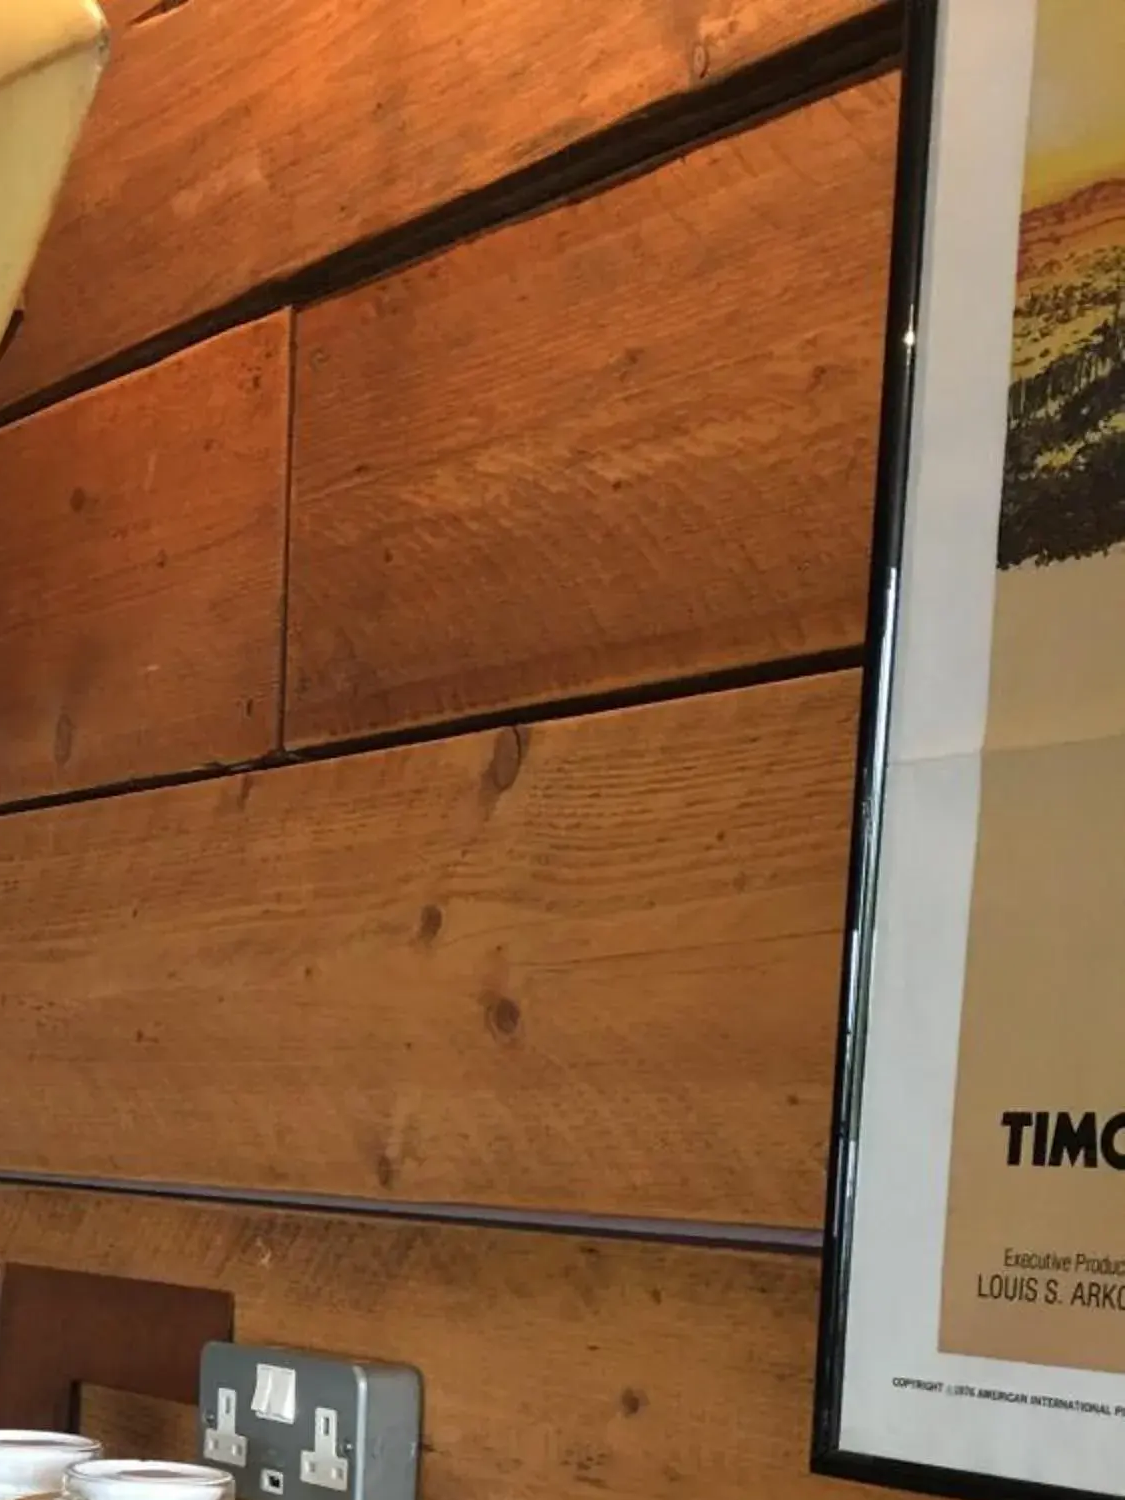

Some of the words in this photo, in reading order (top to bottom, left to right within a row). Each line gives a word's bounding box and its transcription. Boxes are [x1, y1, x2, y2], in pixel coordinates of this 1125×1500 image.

[1004, 1247, 1072, 1272] Executive
[977, 1273, 1038, 1302] LOUIS
[1044, 1279, 1063, 1304] S.
[892, 1377, 944, 1393] COPYRIGHT
[976, 1388, 1028, 1404] AMERICAN
[1030, 1395, 1111, 1416] INTERNATIONAL
